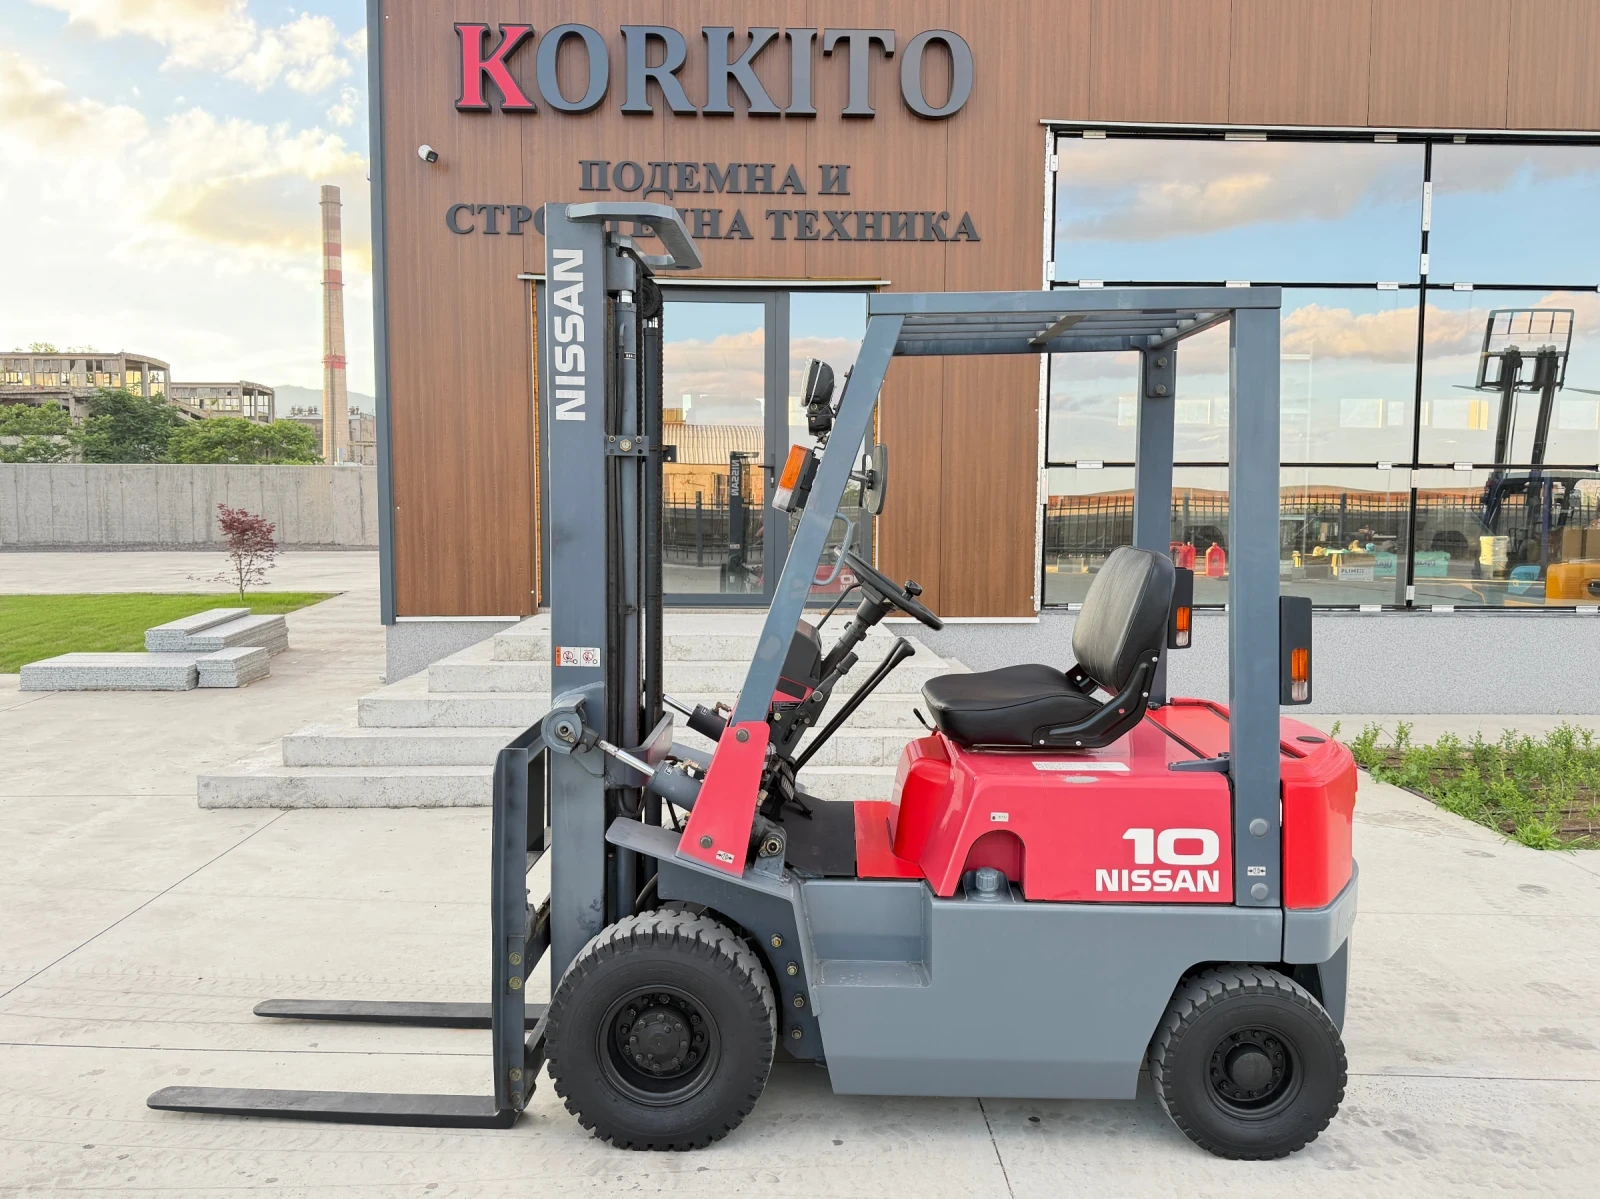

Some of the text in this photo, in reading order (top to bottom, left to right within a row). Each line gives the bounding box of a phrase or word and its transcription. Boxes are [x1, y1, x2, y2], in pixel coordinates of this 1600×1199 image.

[454, 22, 975, 120] KORKITO
[578, 160, 851, 199] ПОДЕМНА И
[766, 209, 981, 242] ТЕХНИКА
[552, 248, 586, 422] NISSAN
[1122, 828, 1220, 865] 10
[1095, 869, 1220, 893] NISSAN
